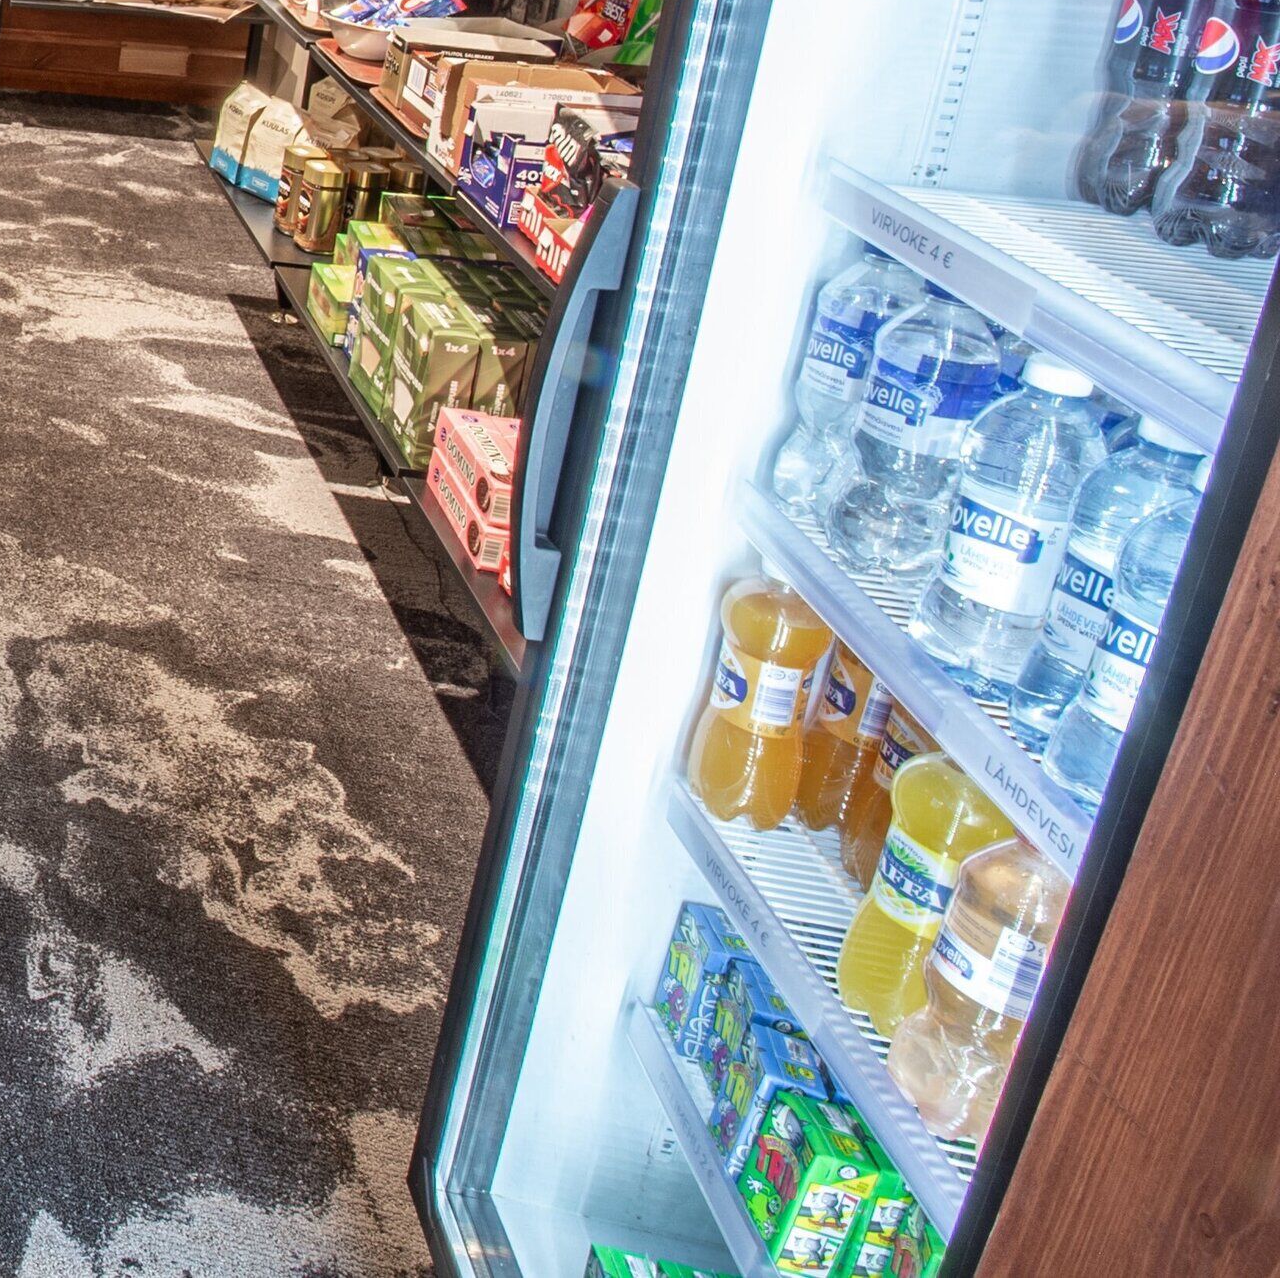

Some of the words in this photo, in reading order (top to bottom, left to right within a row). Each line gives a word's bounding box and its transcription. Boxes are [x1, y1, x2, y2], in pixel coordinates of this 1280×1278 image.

[1148, 6, 1181, 55] MAX
[1246, 35, 1280, 86] MAX
[261, 120, 290, 136] KUULAS
[872, 207, 928, 255] VIRVOKE
[930, 244, 940, 262] 4
[942, 251, 954, 269] €
[446, 437, 476, 487] DOMINO
[439, 478, 467, 530] DOMINO
[985, 755, 1075, 859] LÄHDEVESI
[705, 850, 751, 921] VIRVOKE
[750, 919, 760, 933] 4
